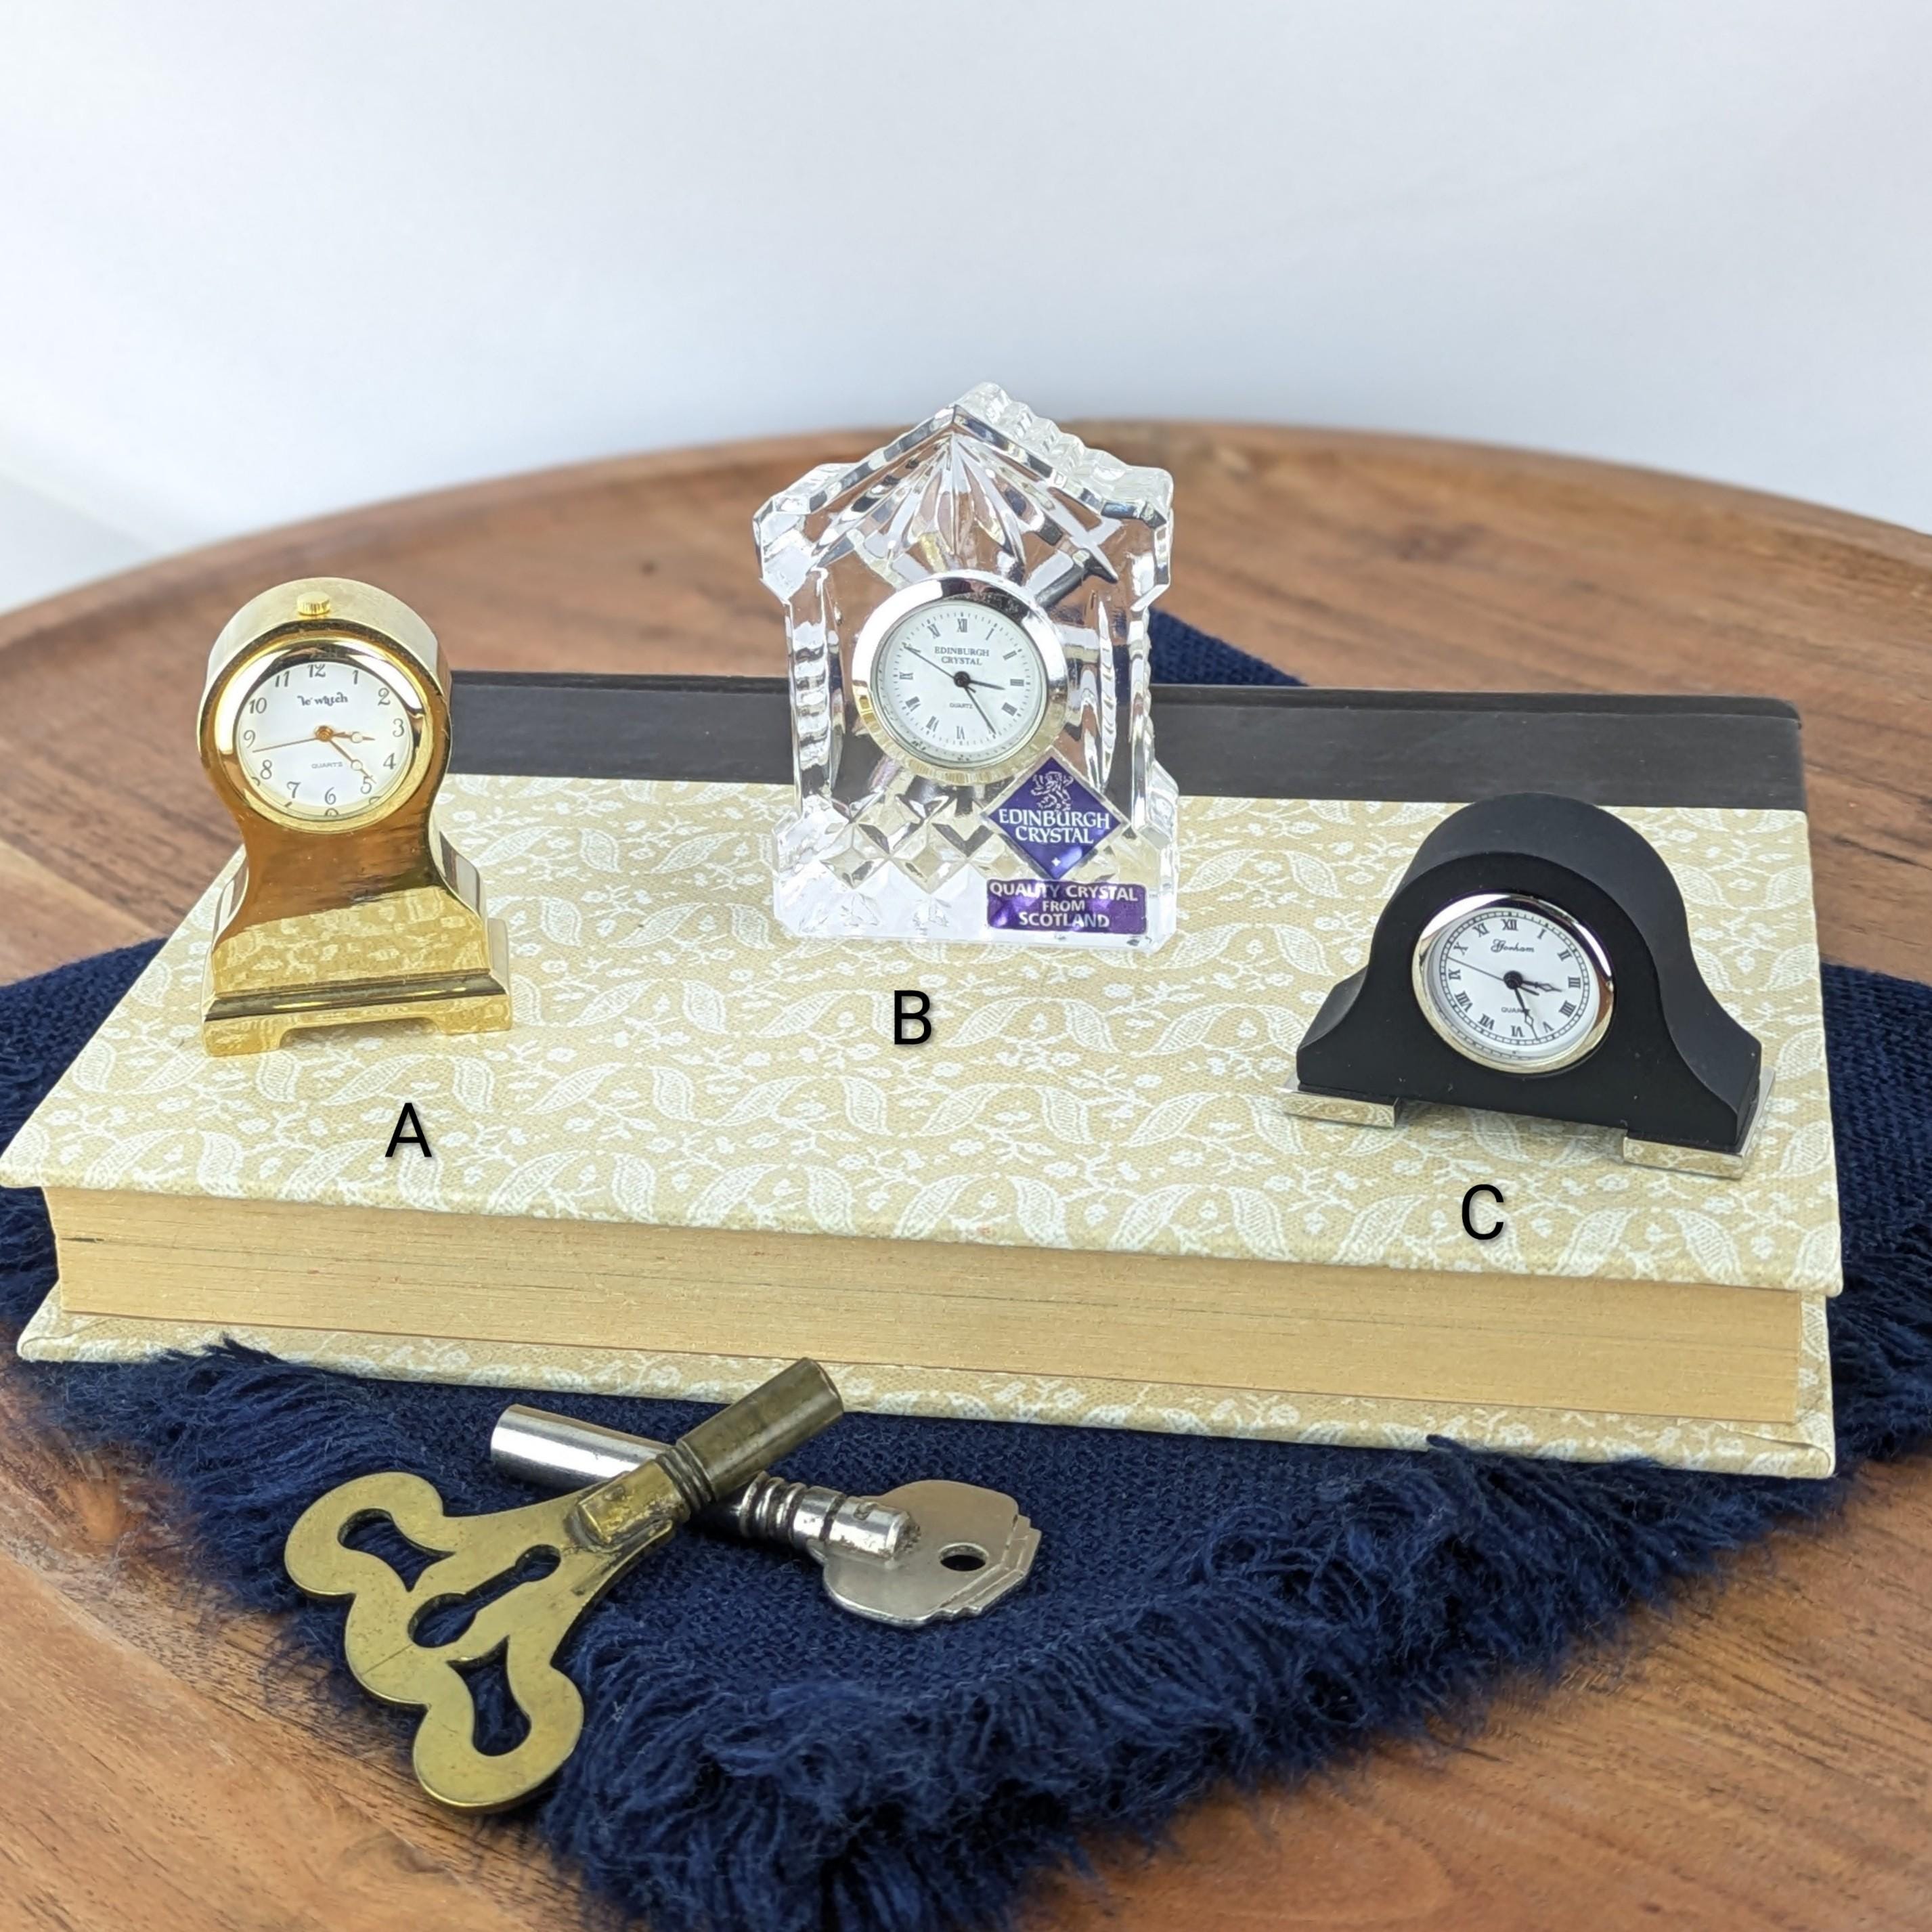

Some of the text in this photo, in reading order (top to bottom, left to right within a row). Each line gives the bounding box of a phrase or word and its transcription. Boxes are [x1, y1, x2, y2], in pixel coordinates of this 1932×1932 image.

[957, 618, 968, 633] XII
[934, 646, 990, 657] EDINBURGH
[941, 656, 982, 666] CRYSTAL
[307, 663, 326, 678] 12
[352, 669, 359, 685] 1
[274, 671, 290, 687] 11
[377, 688, 391, 706] 2
[249, 697, 267, 714] 10
[392, 718, 405, 737] 3
[243, 730, 256, 748] 9
[311, 761, 343, 770] QUARTZ
[383, 753, 396, 770] 4
[260, 760, 273, 780] 8
[286, 781, 301, 799] 7
[360, 775, 374, 794] 5
[324, 787, 337, 805] 6
[998, 808, 1110, 829] EDINBURGH
[1015, 827, 1094, 843] CRYSTAL
[990, 882, 1138, 901] QUALITY CRYSTAL
[1042, 900, 1085, 912] FROM
[1019, 913, 1110, 928] SCOTLAND
[1501, 919, 1518, 931] XII
[1473, 922, 1490, 938] XI
[1537, 928, 1547, 940] I
[1453, 942, 1469, 956] X
[1557, 950, 1573, 962] II
[1448, 969, 1461, 981] IX
[1568, 975, 1581, 990] III
[1455, 990, 1474, 1013] VIII
[1558, 1000, 1577, 1018] IIII
[1478, 1013, 1495, 1030] VII
[1542, 1021, 1554, 1033] V
[1510, 1024, 1525, 1038] VI
